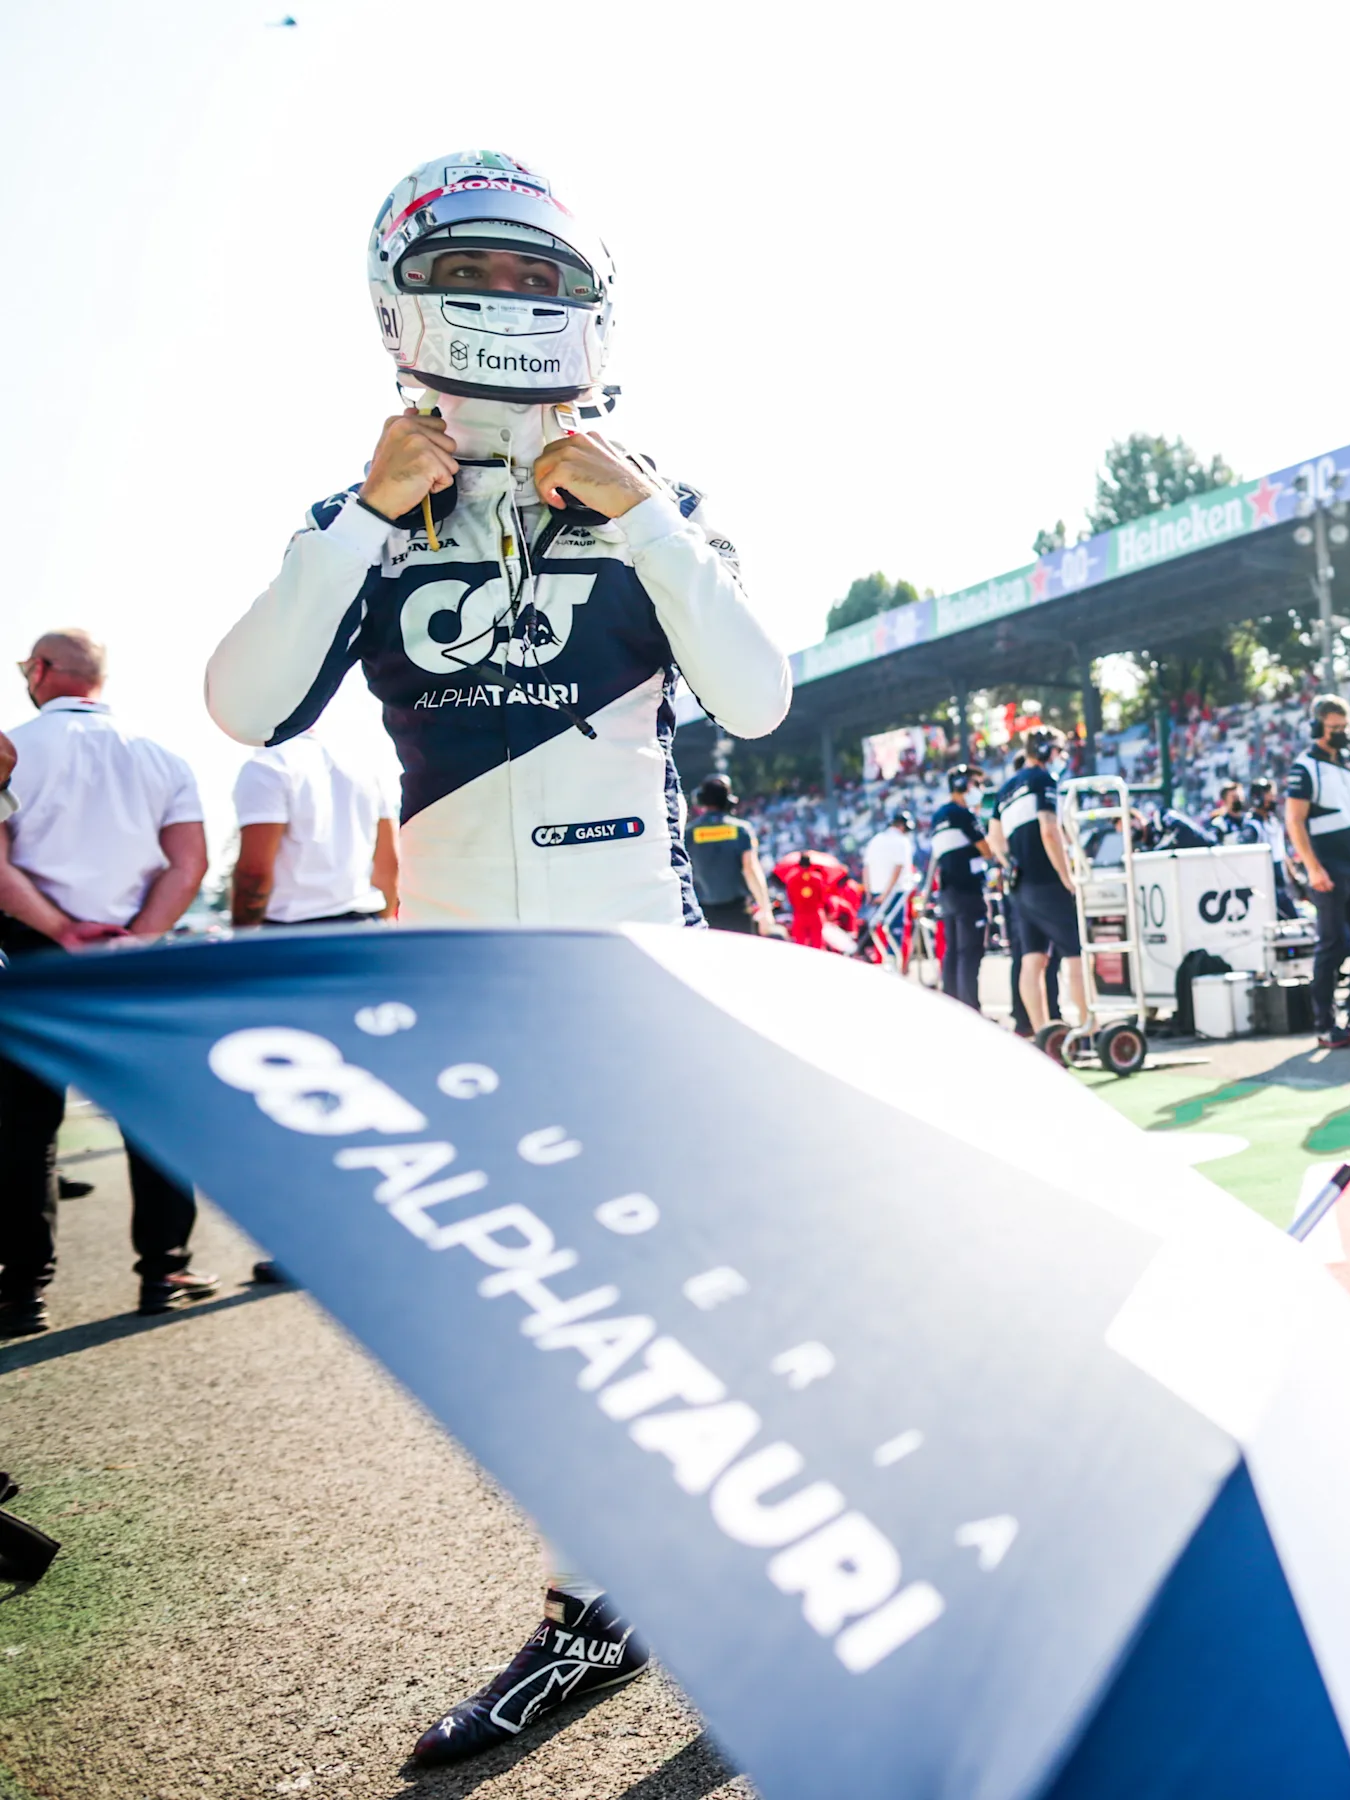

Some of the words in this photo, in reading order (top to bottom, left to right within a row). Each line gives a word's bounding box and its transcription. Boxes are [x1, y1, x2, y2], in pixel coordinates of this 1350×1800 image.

[440, 179, 557, 207] HONDA
[476, 348, 560, 373] fantom
[1116, 498, 1243, 572] Heineken
[575, 823, 617, 840] GASLY
[332, 1141, 945, 1675] ALPHATAURI
